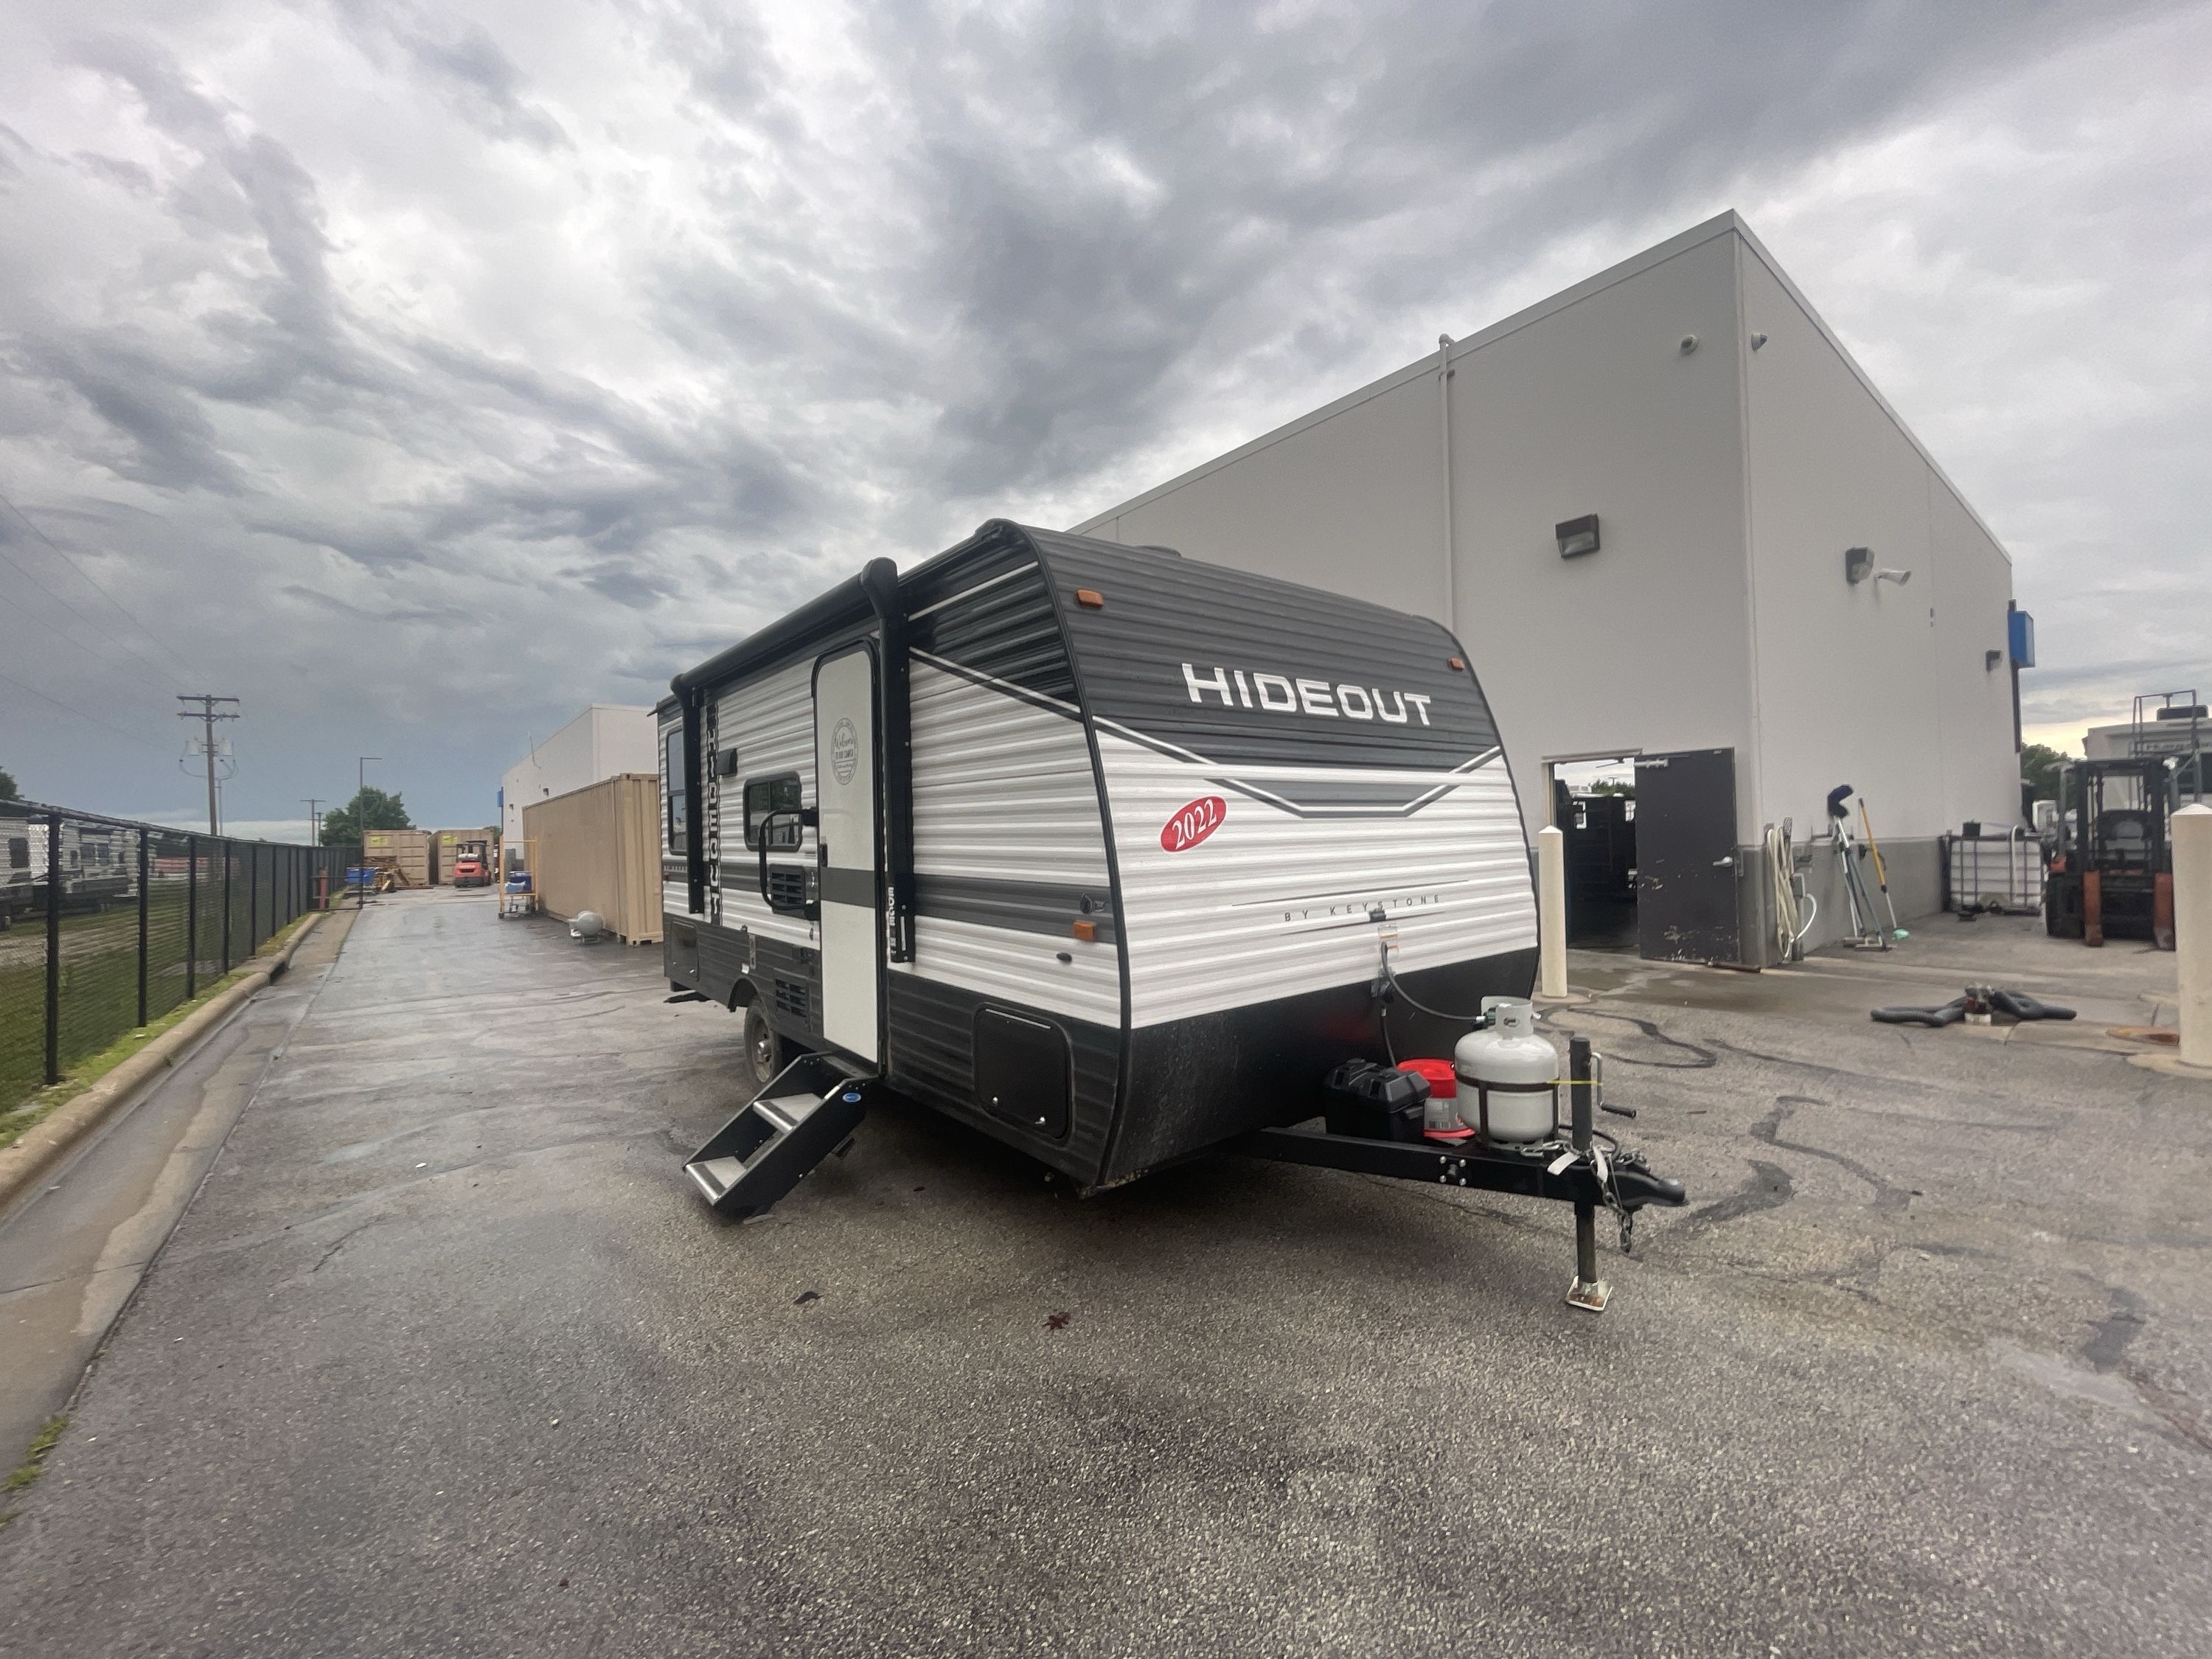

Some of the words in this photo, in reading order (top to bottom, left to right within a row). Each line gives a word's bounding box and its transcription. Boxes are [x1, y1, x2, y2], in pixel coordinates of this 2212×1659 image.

[1182, 663, 1431, 726] HIDEOUT
[707, 728, 720, 915] HIDEOUT
[1172, 799, 1217, 850] 2022
[1284, 909, 1309, 922] BY
[1329, 894, 1439, 916] KEYSTONE
